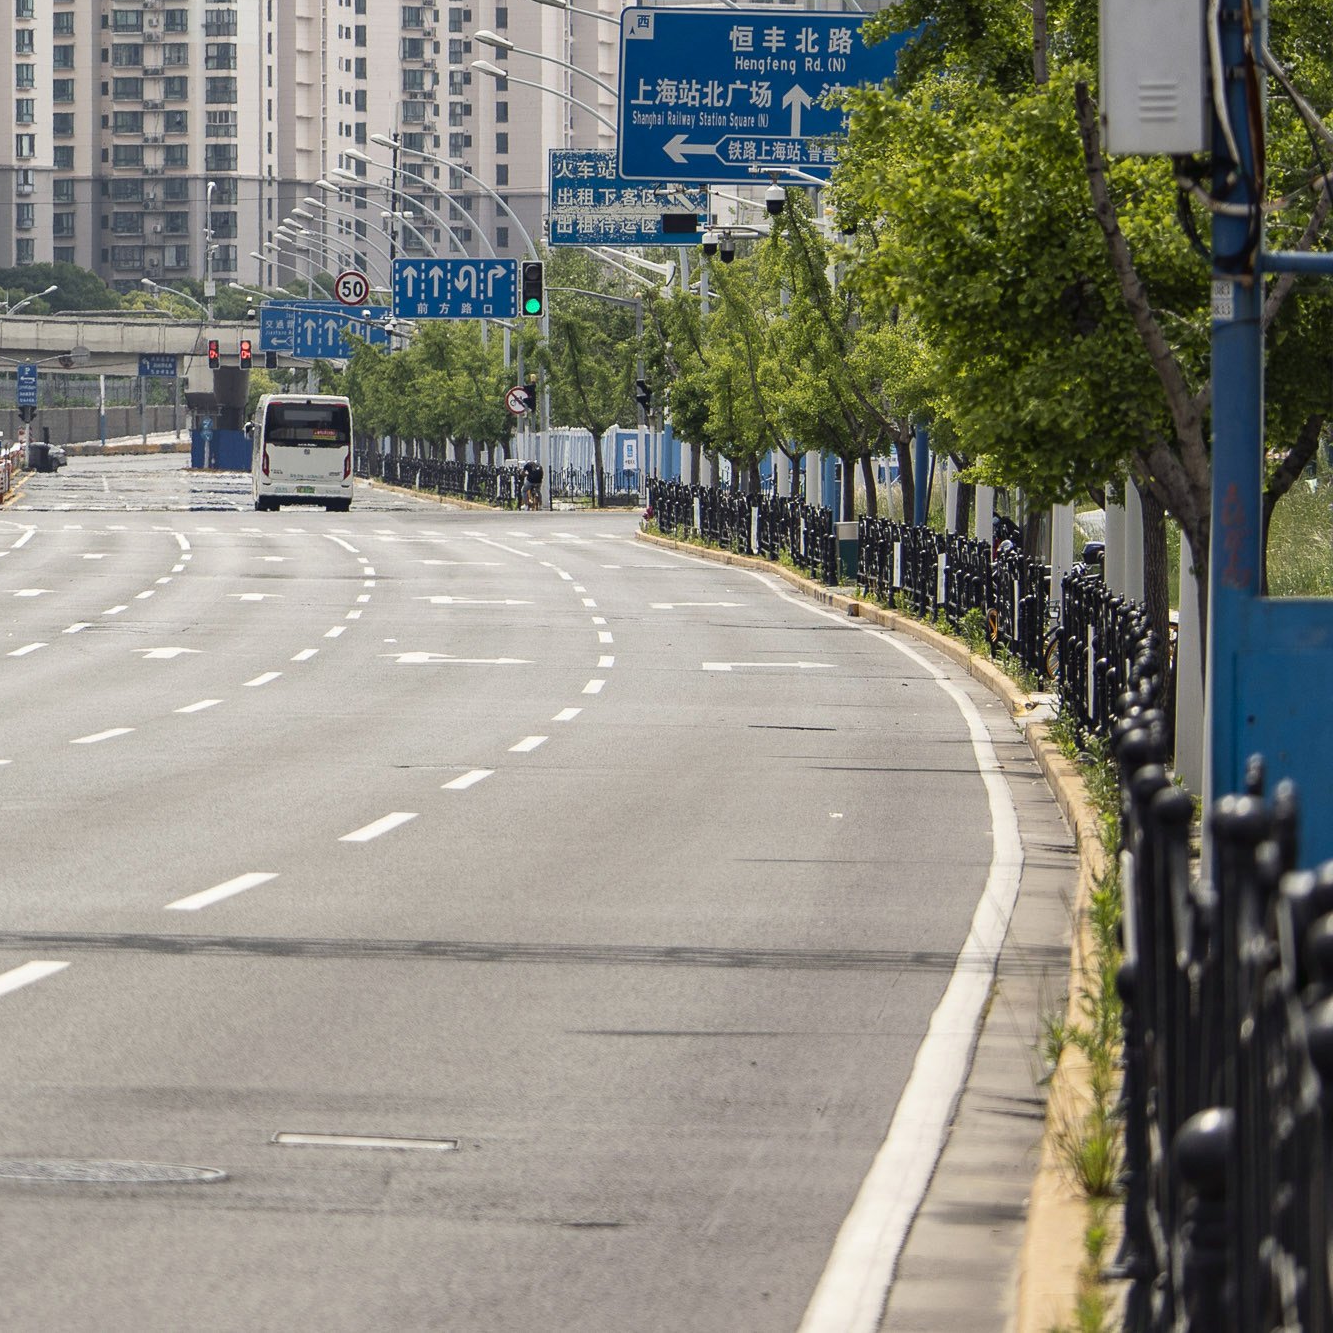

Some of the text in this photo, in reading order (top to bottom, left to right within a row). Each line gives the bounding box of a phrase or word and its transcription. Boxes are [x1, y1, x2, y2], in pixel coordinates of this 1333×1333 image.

[637, 14, 651, 29] 西
[729, 25, 853, 55] 恒丰北路
[735, 56, 796, 75] Hengfeng
[630, 77, 772, 108] 上海站北广场
[632, 112, 664, 130] Shanghai
[667, 113, 695, 129] Railway
[699, 113, 726, 127] Station
[729, 114, 755, 130] Square
[555, 159, 617, 180] 火车站
[557, 187, 659, 207] 出租下客区
[556, 213, 658, 234] 出租待运区
[341, 281, 364, 298] 50
[417, 302, 494, 315] 前方路口
